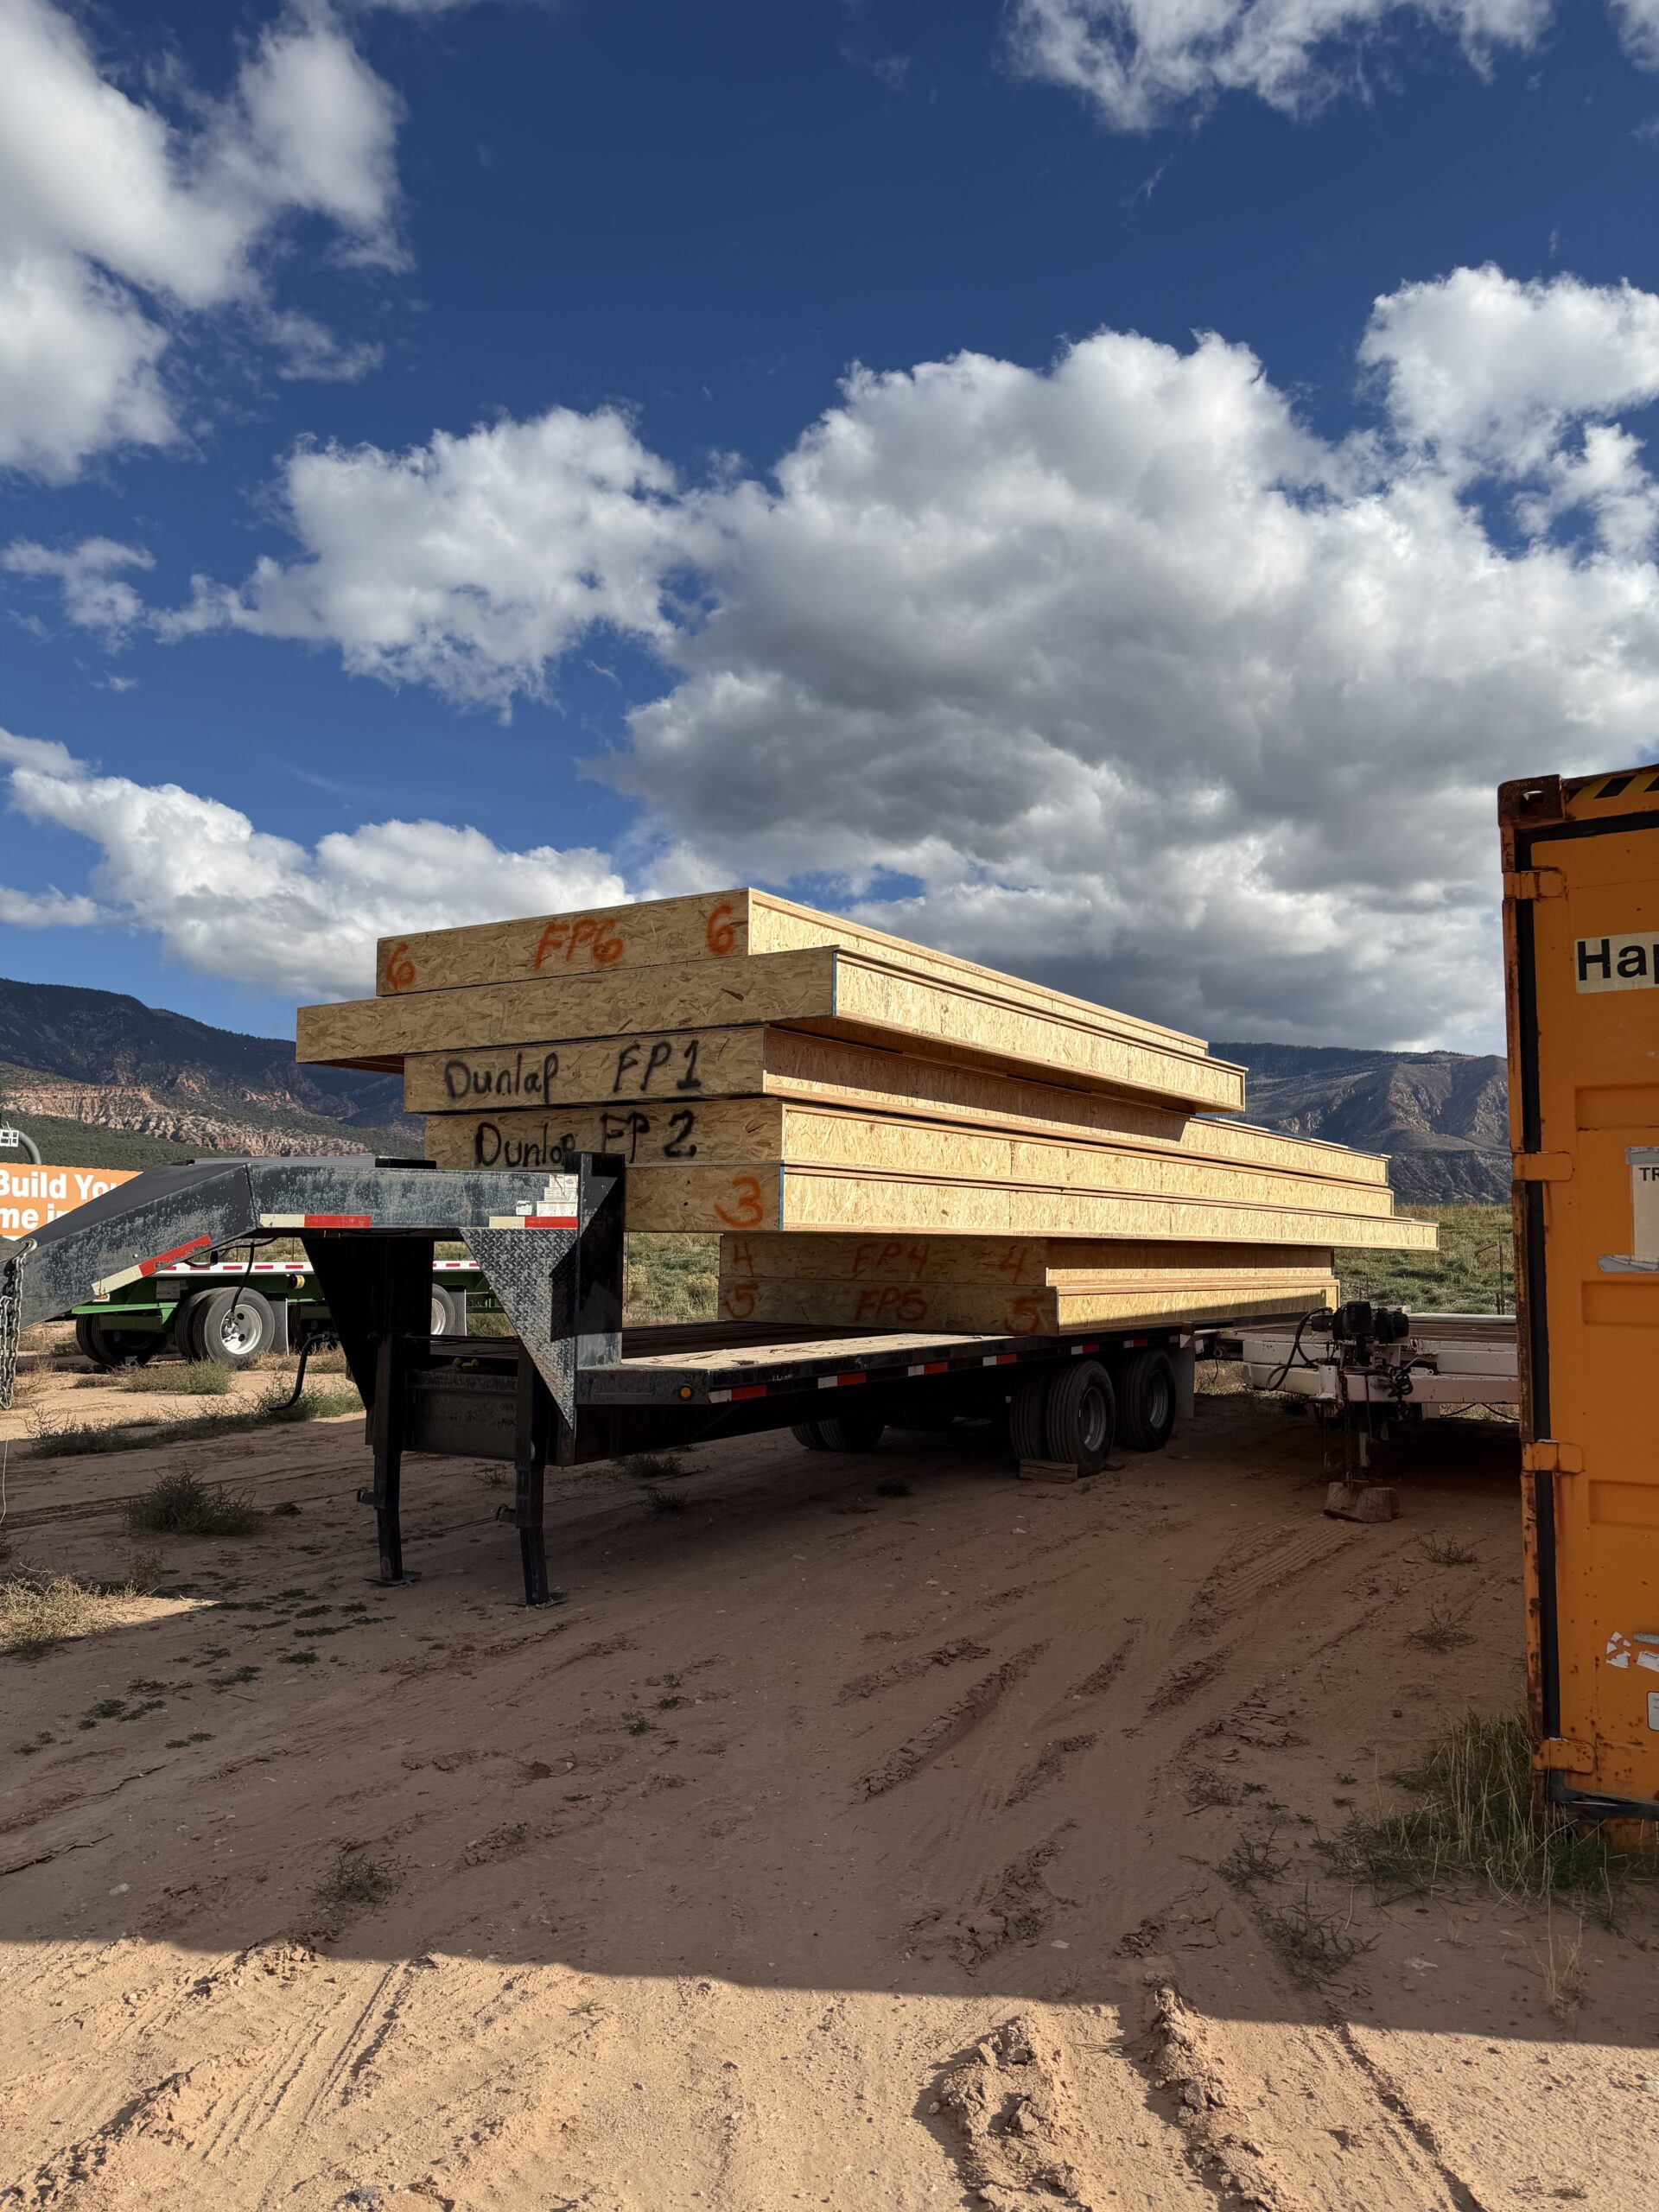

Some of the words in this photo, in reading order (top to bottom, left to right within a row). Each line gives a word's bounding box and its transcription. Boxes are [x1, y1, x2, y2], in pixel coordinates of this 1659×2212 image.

[387, 942, 416, 991] 6
[535, 917, 624, 970] FP6
[706, 903, 734, 957] 6
[1577, 938, 1659, 984] Ha
[444, 1052, 559, 1105] Dunlap
[613, 1039, 702, 1093] FP1
[0, 1169, 67, 1199] Build
[714, 1176, 764, 1228] 3
[733, 1242, 755, 1277] 4
[850, 1241, 931, 1279] FP4
[997, 1246, 1028, 1286] 4
[723, 1282, 759, 1320] 5
[1003, 1295, 1045, 1336] 5
